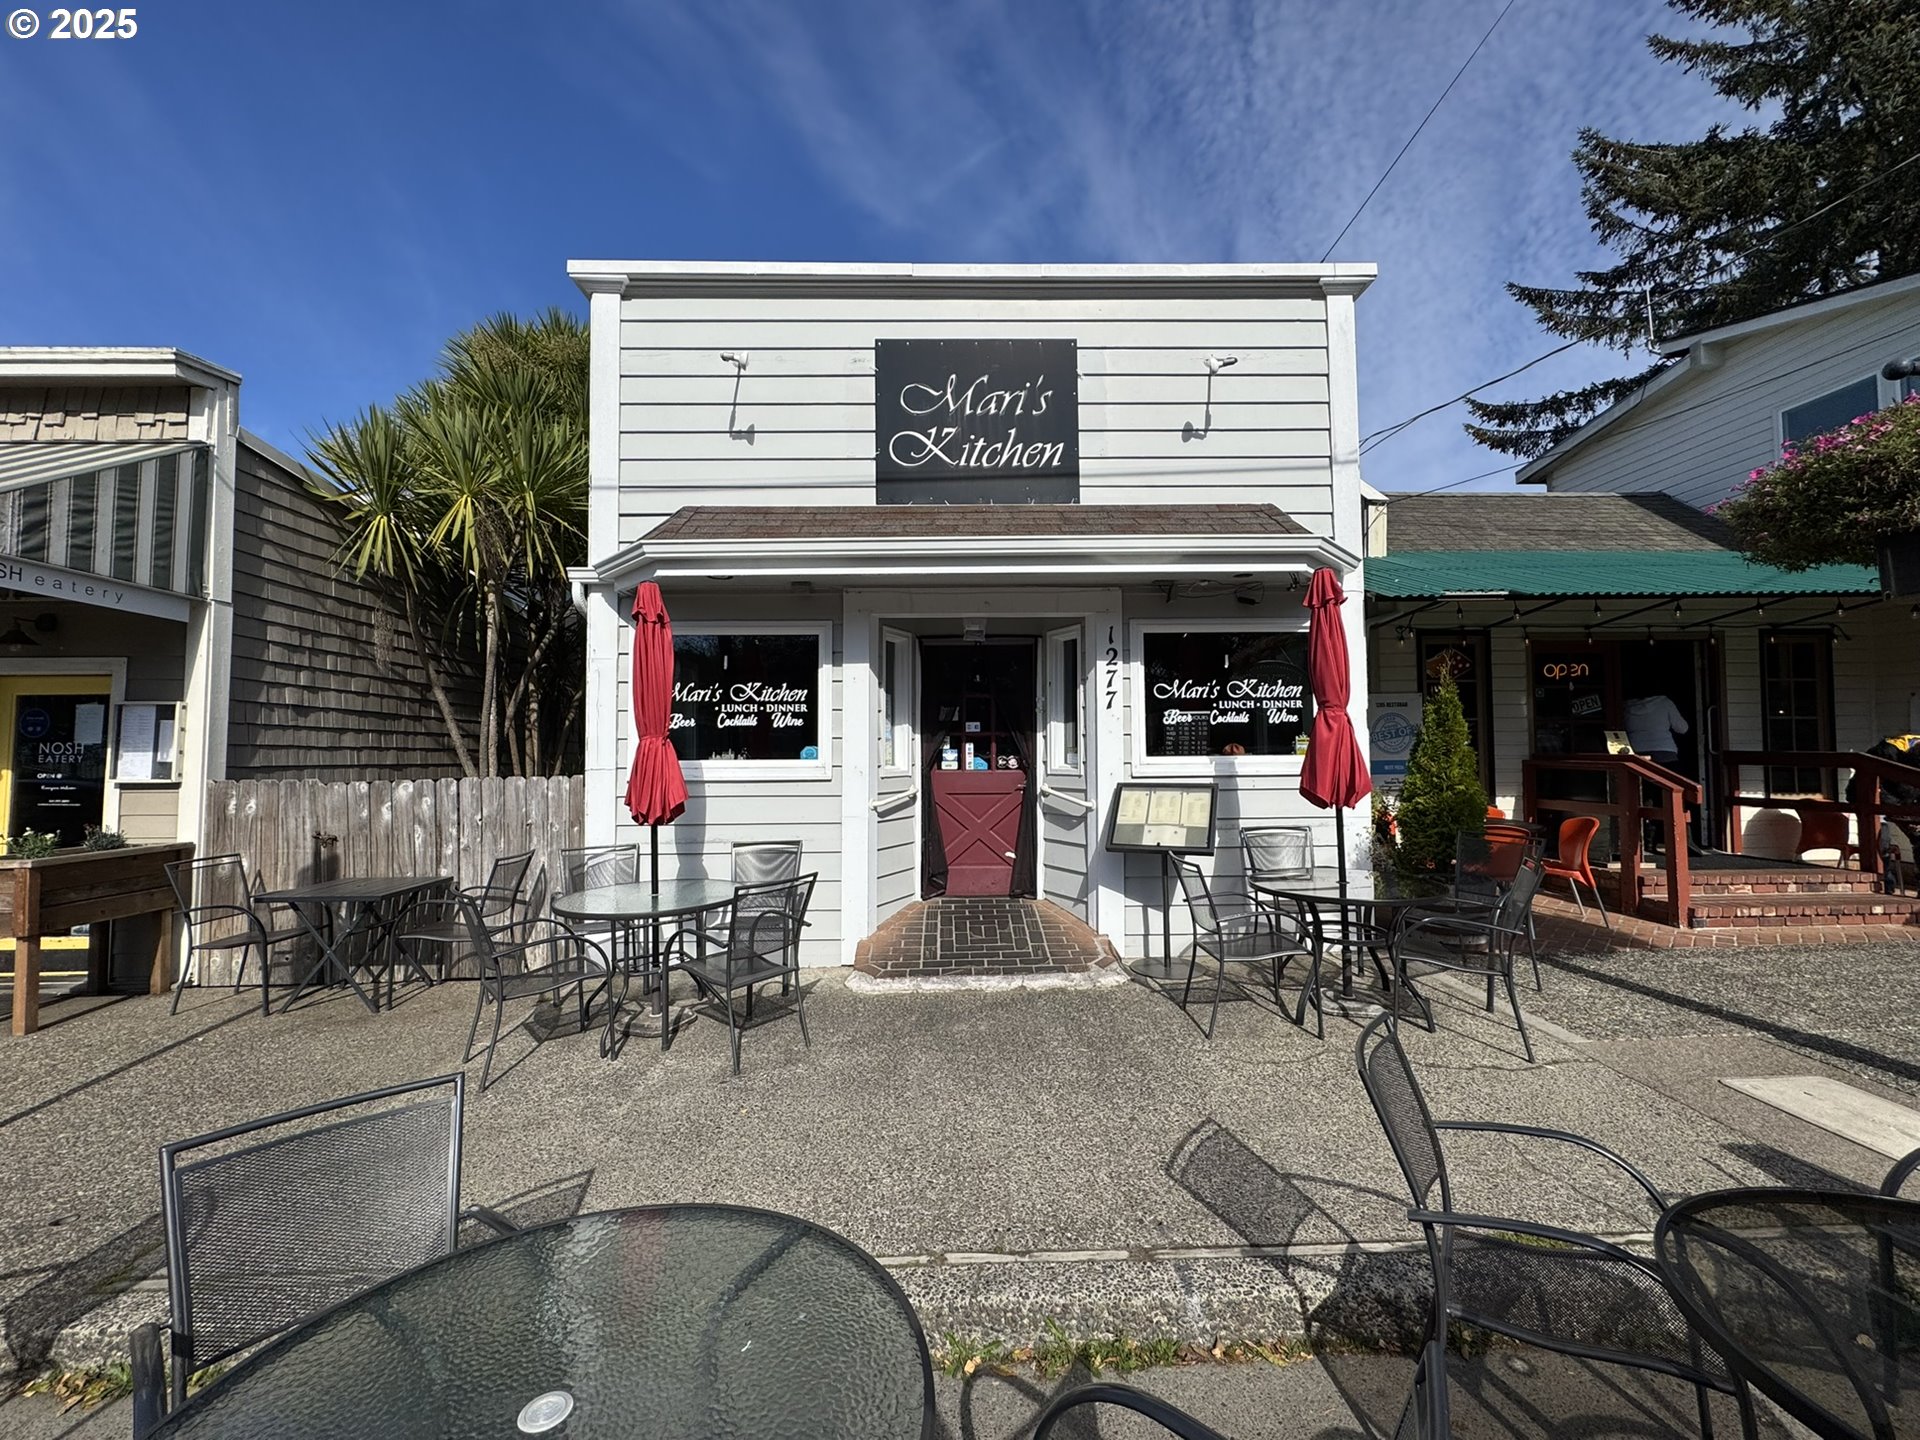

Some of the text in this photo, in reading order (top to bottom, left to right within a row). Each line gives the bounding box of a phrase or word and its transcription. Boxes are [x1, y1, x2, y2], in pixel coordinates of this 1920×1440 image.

[900, 374, 1053, 416] Mari's
[889, 426, 1065, 468] Kitchen
[34, 575, 124, 604] eatery
[1106, 626, 1118, 710] 1277
[671, 682, 808, 702] Mari's Kitchen
[1153, 679, 1303, 699] Mari's Kitchen
[721, 703, 808, 713] LUNCH DINNER
[1219, 700, 1303, 709] LUNCH DINNER
[1571, 695, 1599, 712] OPEN
[669, 712, 804, 729] Beer Cocktails Wine
[1163, 708, 1299, 725] Beer Cocktails Wine
[1371, 729, 1397, 743] BEST
[1398, 726, 1412, 738] OF
[39, 742, 85, 755] NOSH
[38, 755, 84, 763] EATERY
